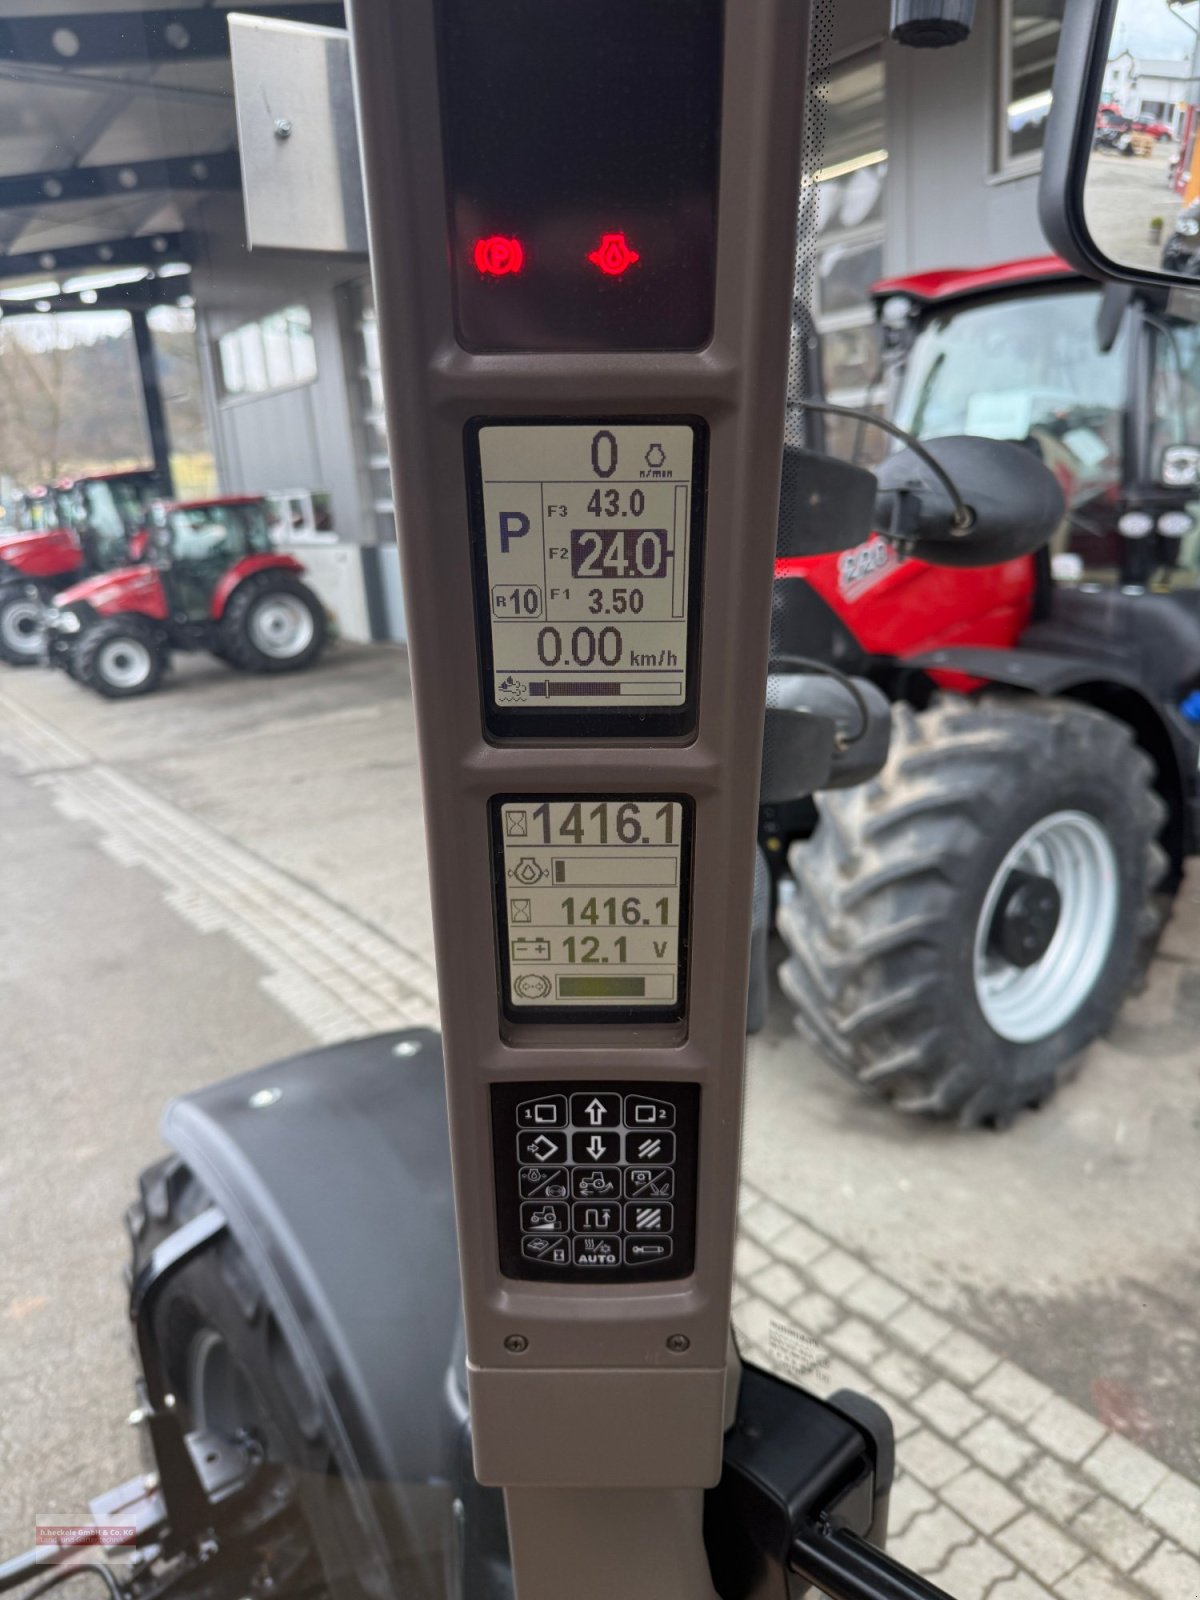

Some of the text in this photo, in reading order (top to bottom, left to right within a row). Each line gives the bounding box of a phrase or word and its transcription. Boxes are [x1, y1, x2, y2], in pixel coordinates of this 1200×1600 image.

[591, 430, 618, 478] 0
[547, 489, 645, 517] F3 43.0
[499, 511, 531, 553] P
[549, 531, 662, 577] F2 24.0
[550, 588, 644, 614] F1 3.50
[537, 626, 677, 667] 0.00 km/h
[532, 803, 674, 844] 1416.1
[561, 897, 669, 925] 1416.1
[562, 936, 627, 963] 12.1
[524, 1109, 532, 1118] 1
[659, 1109, 667, 1118] 2
[578, 1254, 616, 1263] AUTO
